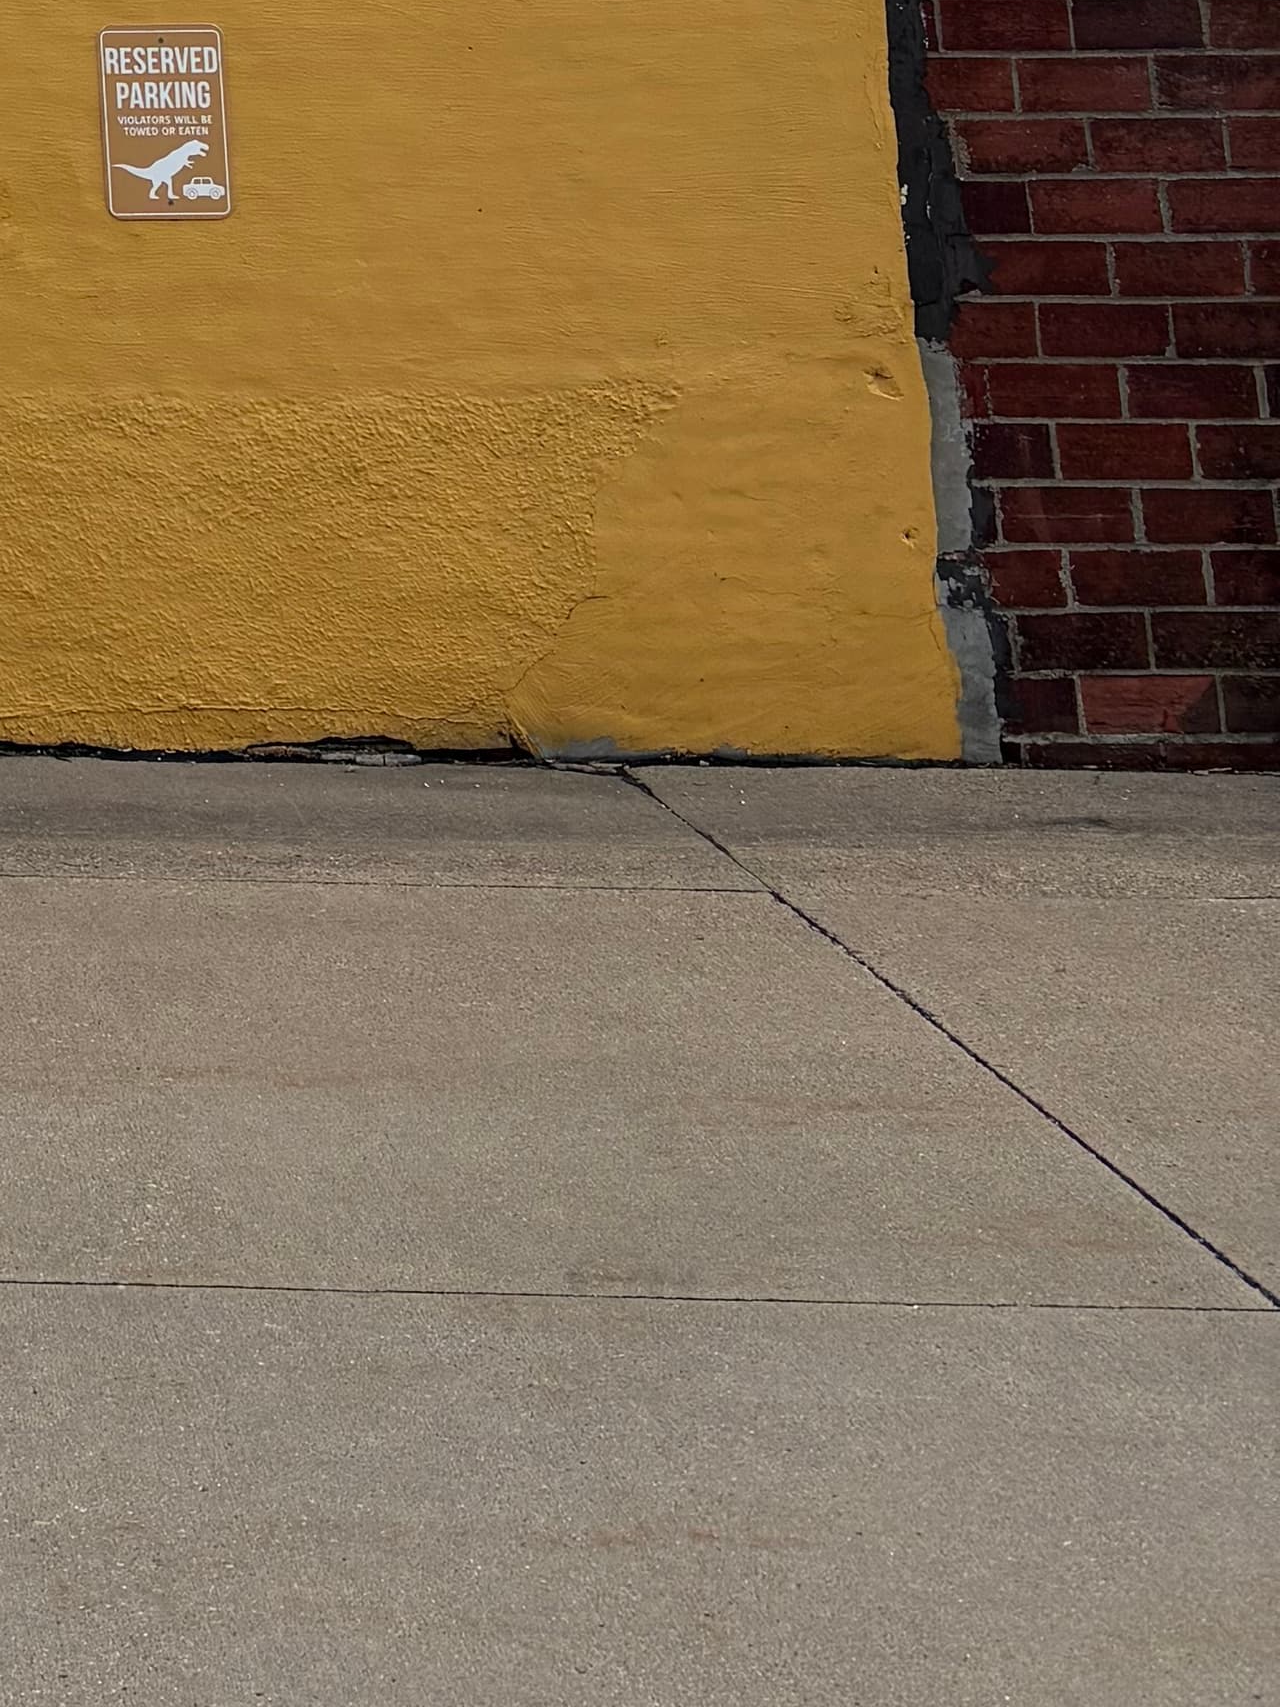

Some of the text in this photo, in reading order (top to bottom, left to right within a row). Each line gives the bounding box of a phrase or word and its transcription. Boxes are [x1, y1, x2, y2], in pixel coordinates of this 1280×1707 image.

[105, 46, 218, 75] RESERVED
[116, 81, 211, 109] PARKING
[117, 115, 213, 125] VIOLATORS WILL BE
[123, 126, 209, 136] TOWED OR EATEN
